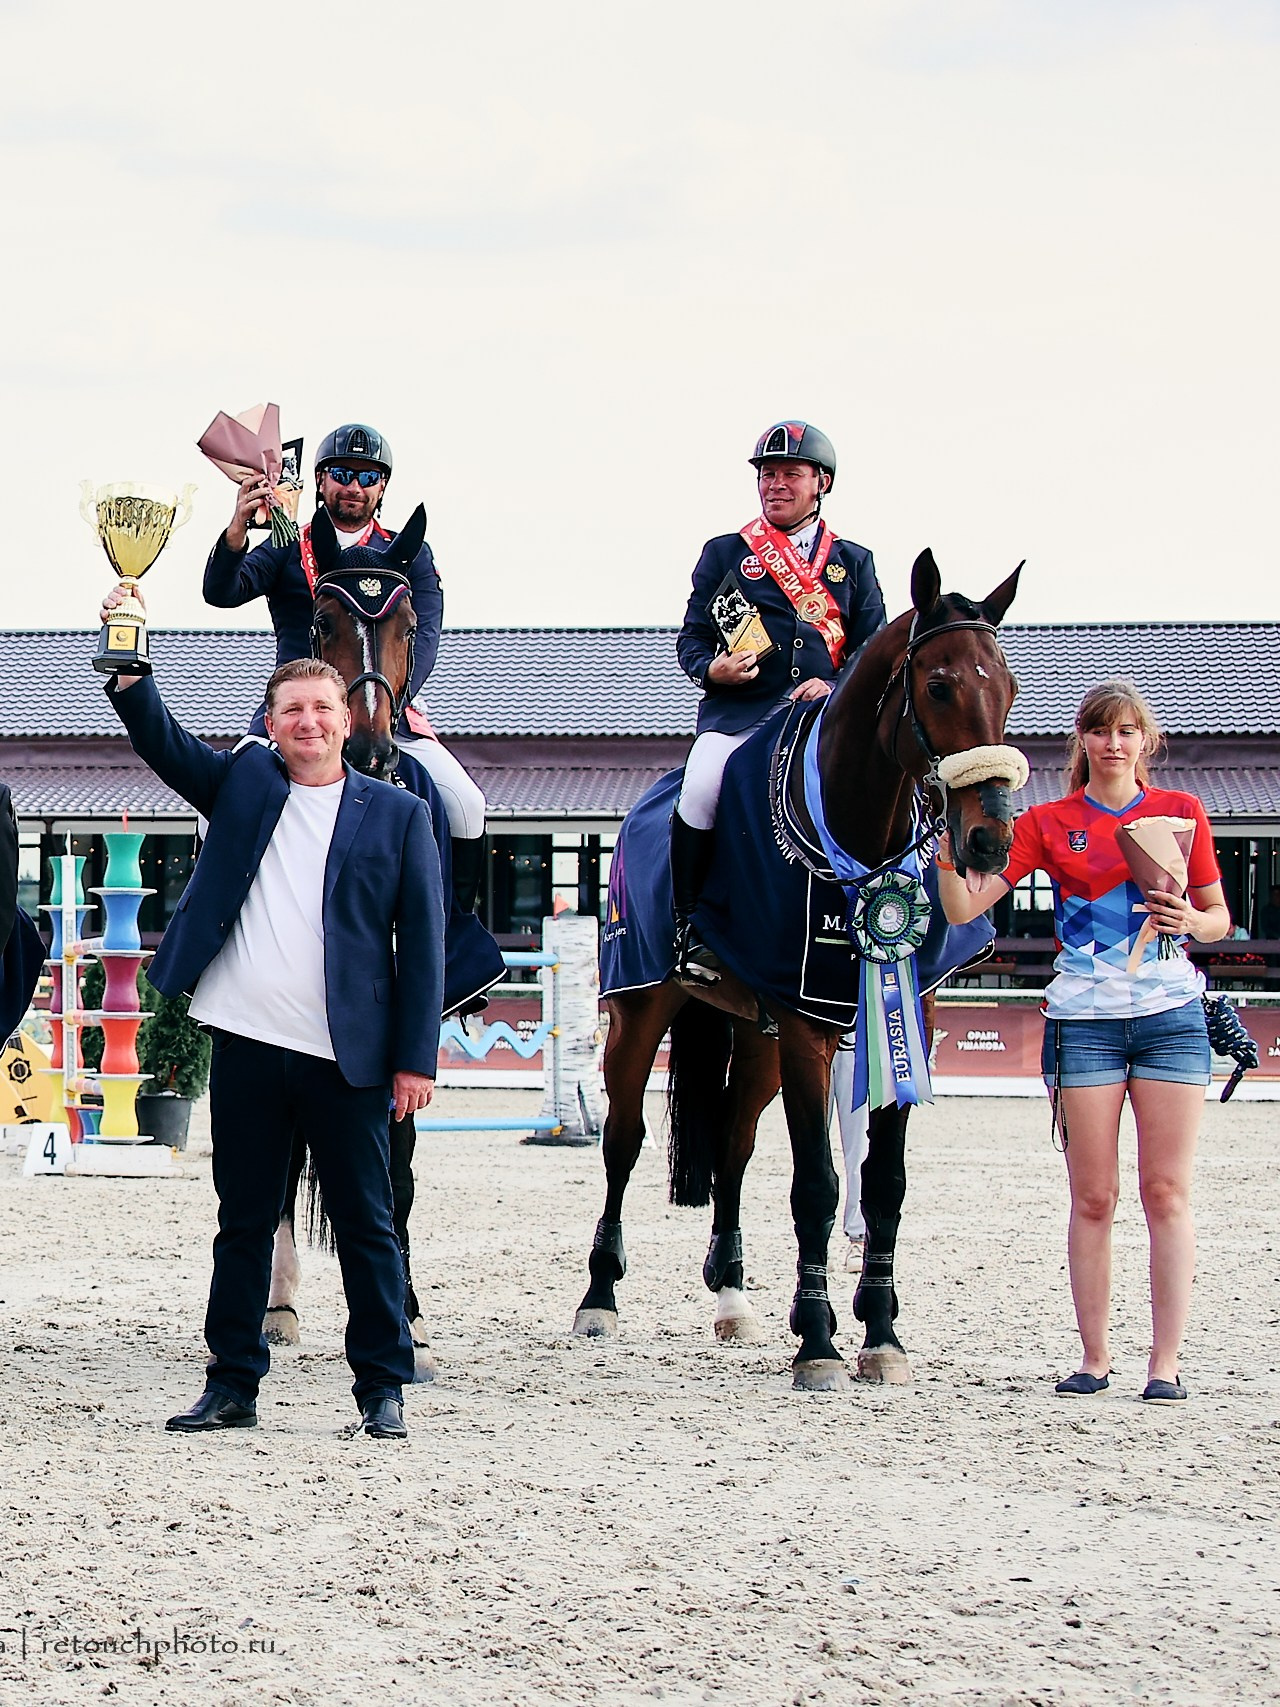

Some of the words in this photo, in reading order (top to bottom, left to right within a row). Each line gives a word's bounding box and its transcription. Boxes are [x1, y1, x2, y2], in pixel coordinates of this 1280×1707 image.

[745, 566, 763, 574] A101
[757, 540, 806, 602] ПОБЕДИ
[888, 1008, 911, 1083] EURASIA
[43, 1131, 57, 1166] 4
